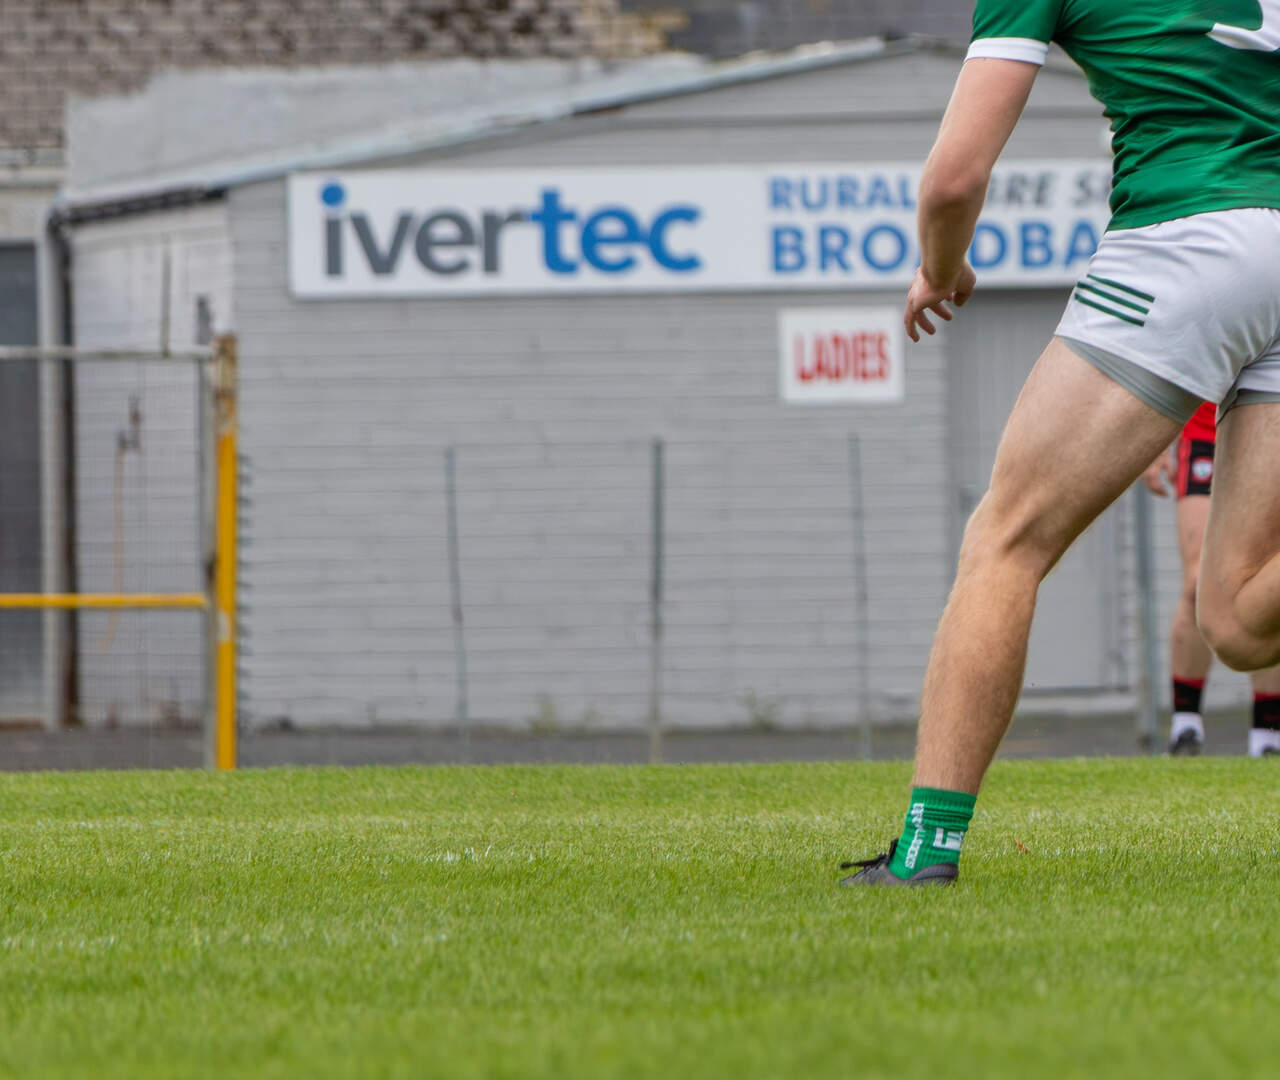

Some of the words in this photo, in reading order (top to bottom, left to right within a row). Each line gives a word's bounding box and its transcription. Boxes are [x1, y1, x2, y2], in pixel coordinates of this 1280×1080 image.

[768, 174, 919, 213] RURAL
[320, 179, 704, 277] ivertec
[771, 221, 1098, 274] BRODBA
[795, 331, 891, 384] LADIES
